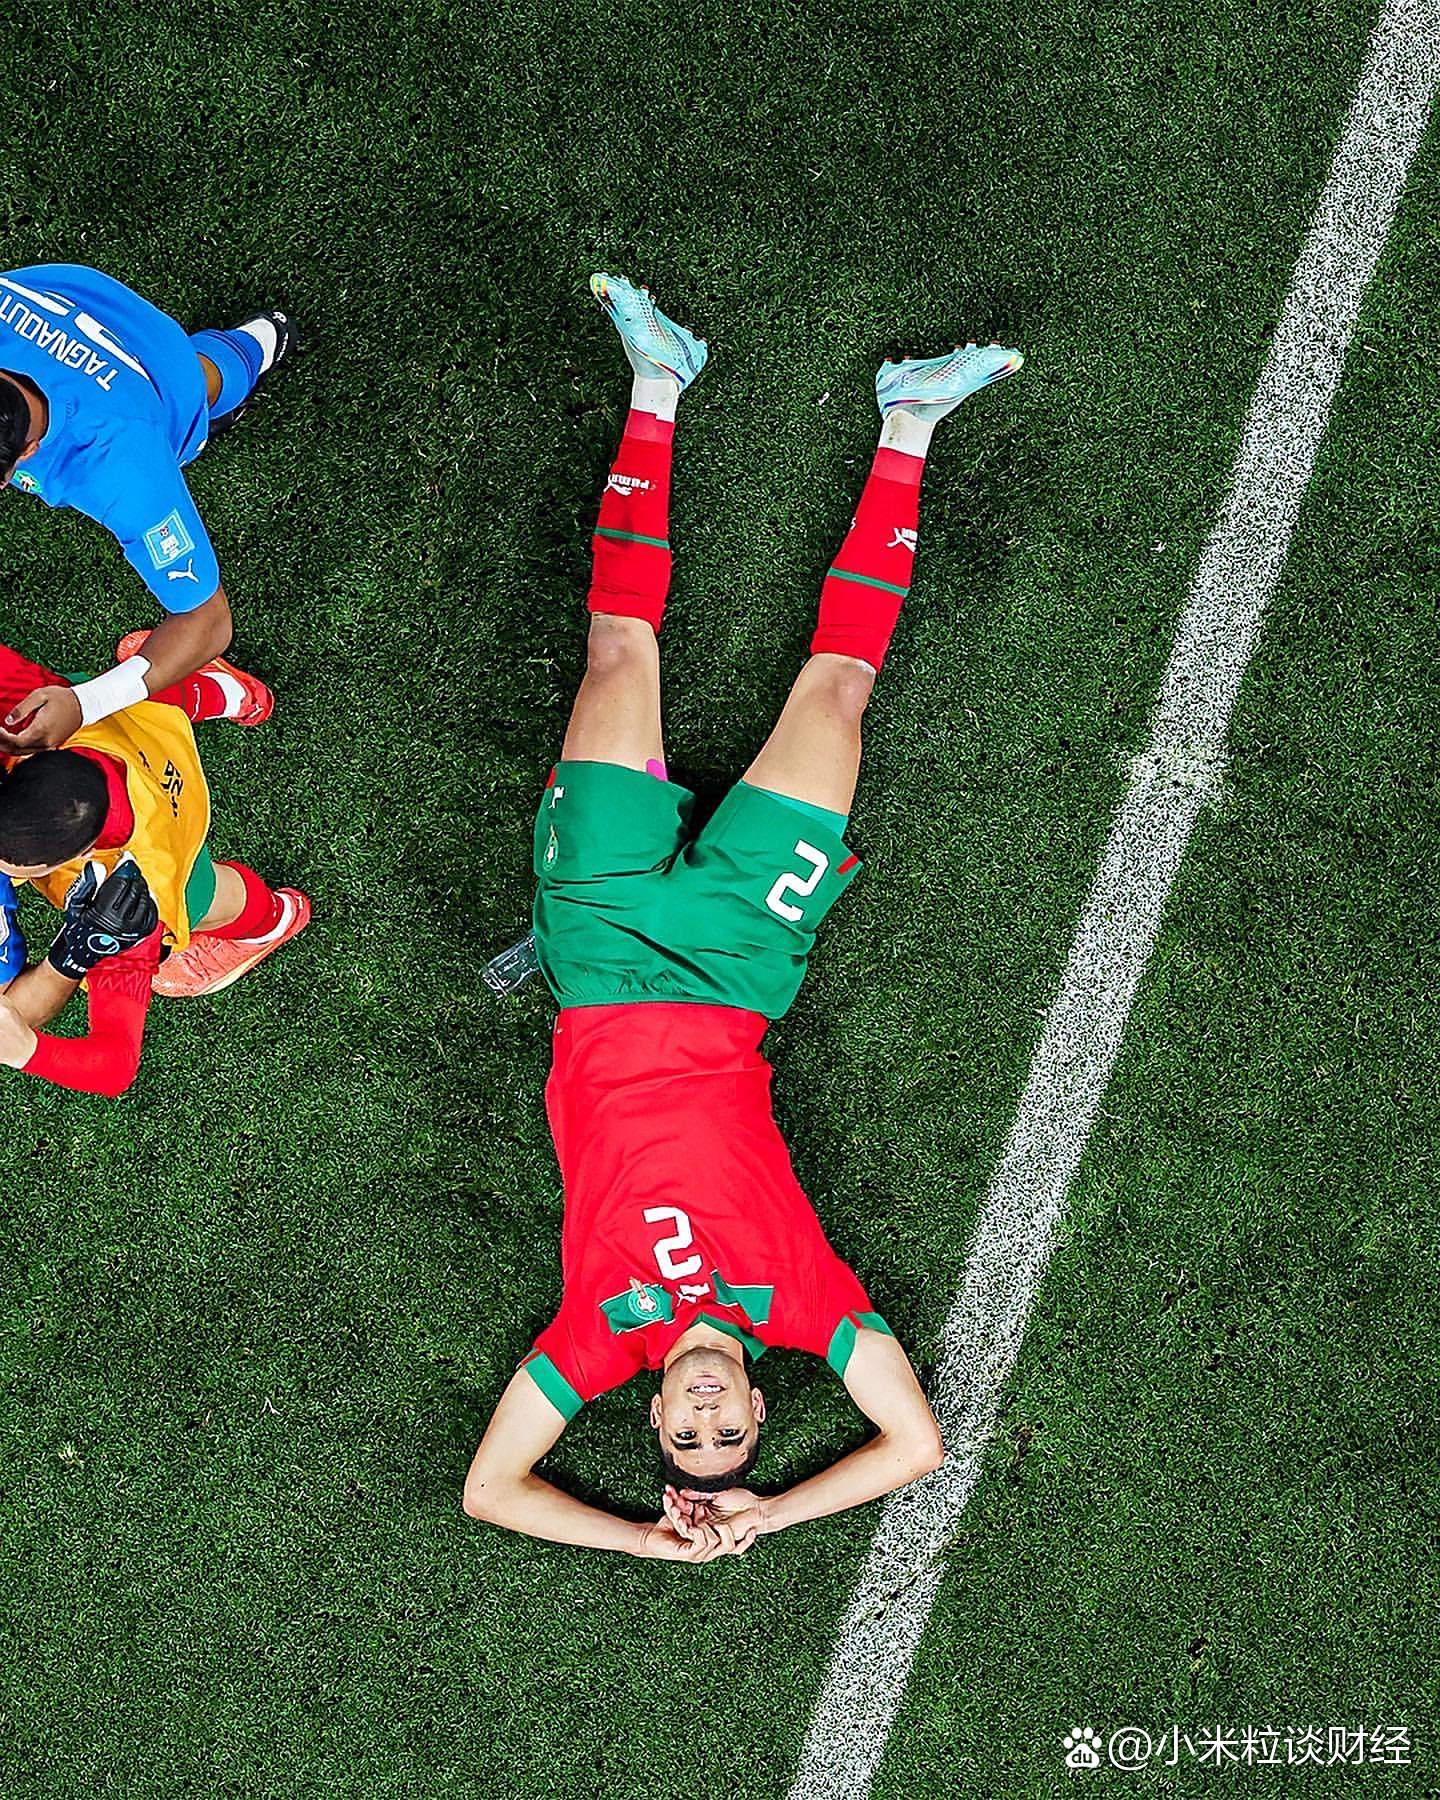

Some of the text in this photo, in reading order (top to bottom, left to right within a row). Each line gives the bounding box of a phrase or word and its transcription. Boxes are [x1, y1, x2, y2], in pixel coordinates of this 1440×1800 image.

[0, 291, 119, 391] TAGNAOUT
[764, 839, 830, 923] 2
[642, 1206, 703, 1281] 2
